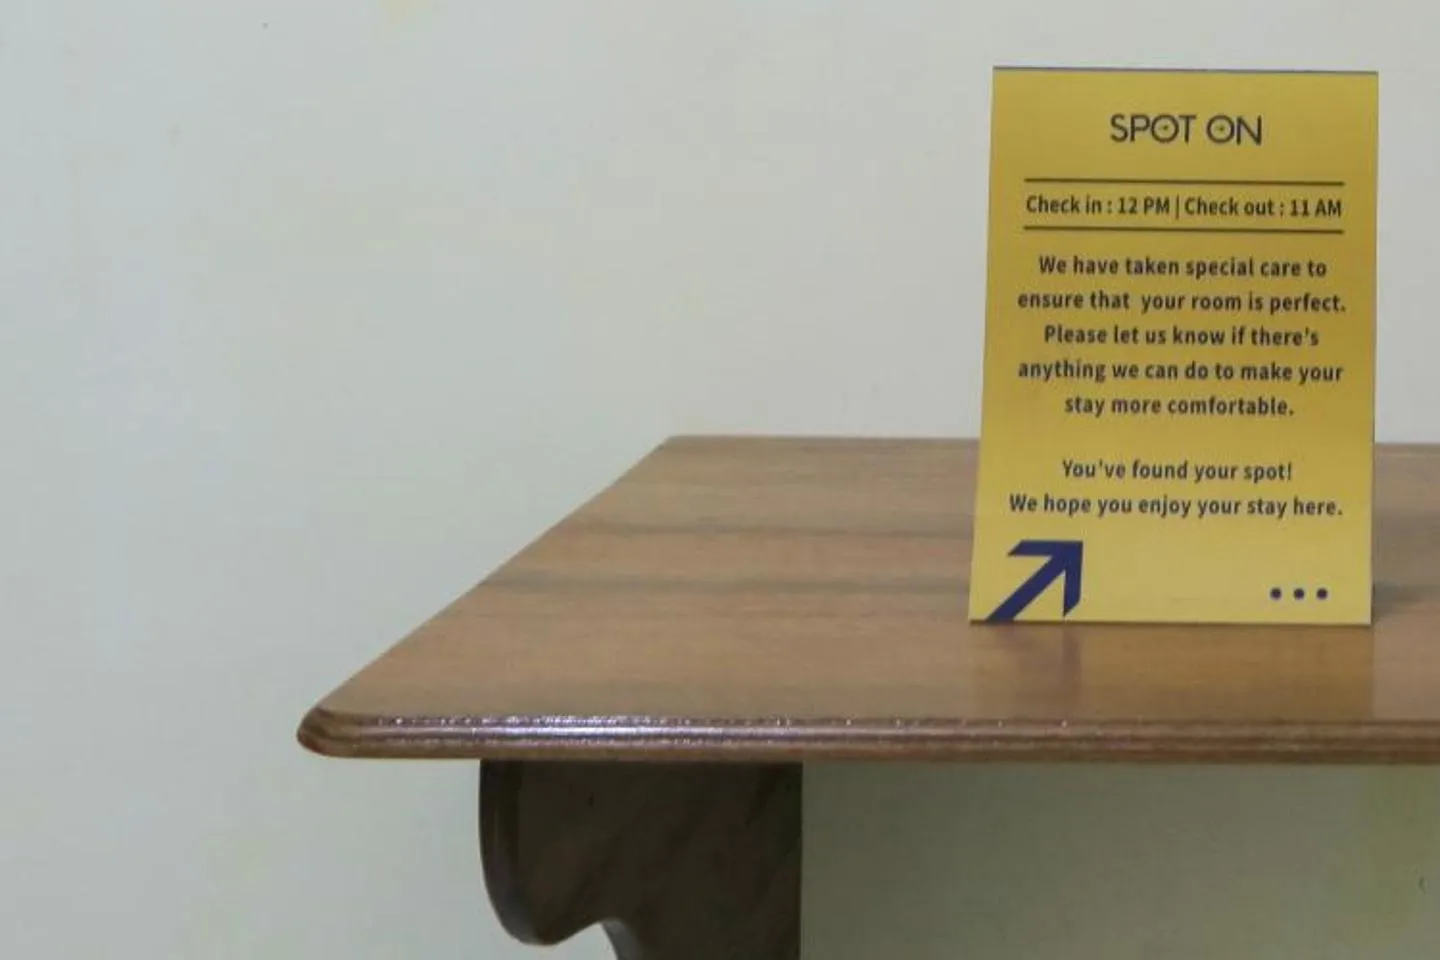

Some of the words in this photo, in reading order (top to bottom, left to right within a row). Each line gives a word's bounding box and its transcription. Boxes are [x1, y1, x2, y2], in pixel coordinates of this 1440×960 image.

[1110, 113, 1197, 144] SPOT
[1205, 114, 1263, 146] ON
[1026, 194, 1081, 214] Check
[1085, 195, 1103, 215] in
[1117, 195, 1138, 215] 12
[1143, 195, 1171, 216] PM
[1184, 195, 1239, 216] Check
[1243, 199, 1275, 217] out
[1290, 198, 1310, 218] 11
[1314, 198, 1342, 218] AM
[1038, 255, 1067, 275] We
[1072, 255, 1119, 276] have
[1125, 256, 1180, 276] taken
[1185, 256, 1255, 281] special
[1259, 261, 1301, 277] care
[1306, 259, 1327, 278] to
[1017, 293, 1085, 309] ensure
[1089, 289, 1130, 310] that
[1141, 295, 1186, 315] your
[1191, 295, 1242, 312] room
[1248, 292, 1264, 312] is
[1269, 292, 1346, 316] perfect.
[1044, 323, 1108, 344] Please
[1113, 324, 1139, 345] let
[1145, 329, 1167, 345] us
[1172, 325, 1226, 346] know
[1231, 325, 1246, 346] if
[1250, 325, 1319, 347] there's
[1018, 359, 1107, 384] anything
[1111, 364, 1140, 379] we
[1144, 364, 1179, 381] can
[1184, 360, 1209, 381] do
[1214, 362, 1234, 381] to
[1240, 361, 1293, 382] make
[1298, 366, 1343, 386] your
[1064, 395, 1106, 419] stay
[1111, 398, 1162, 415] more
[1167, 395, 1295, 417] comfortable.
[1062, 459, 1126, 480] You've
[1132, 459, 1189, 480] found
[1194, 465, 1239, 485] your
[1243, 461, 1292, 485] spot!
[1009, 493, 1038, 513] We
[1043, 493, 1092, 517] hope
[1097, 498, 1133, 518] you
[1137, 494, 1192, 519] enjoy
[1197, 499, 1242, 519] your
[1247, 497, 1288, 520] stay
[1293, 495, 1343, 516] here.
